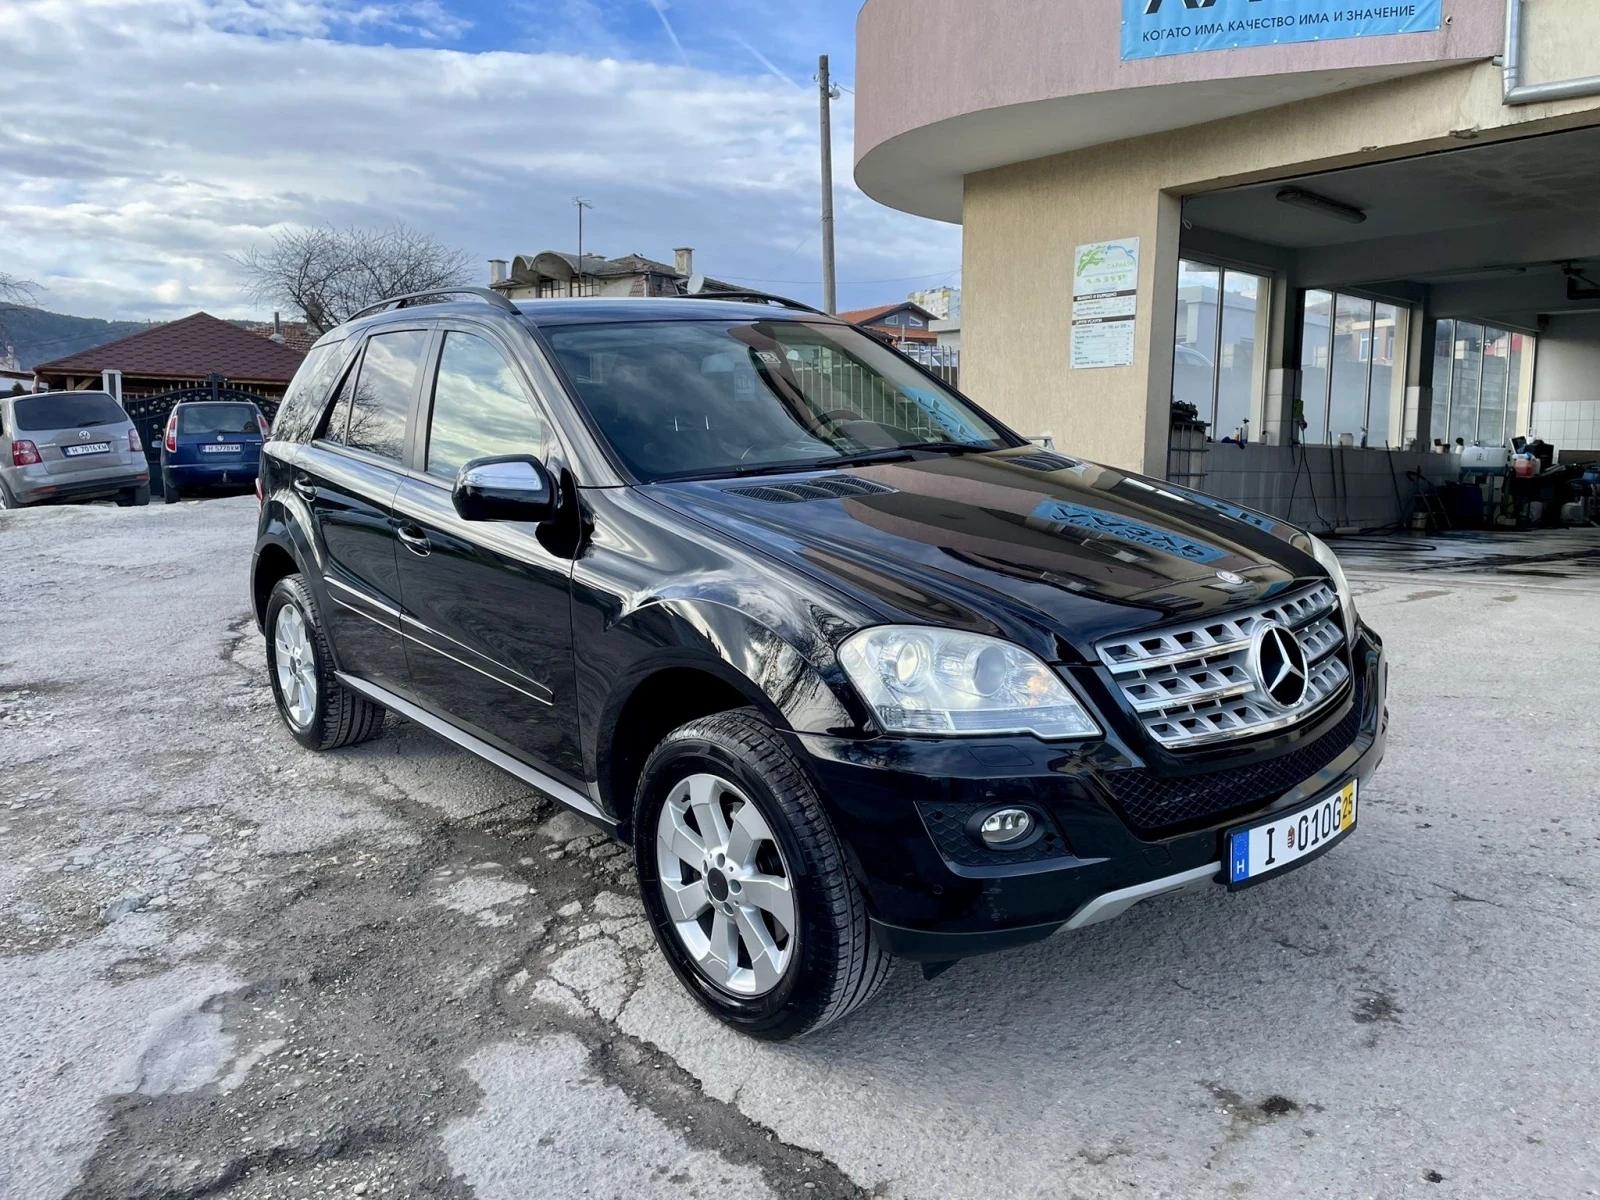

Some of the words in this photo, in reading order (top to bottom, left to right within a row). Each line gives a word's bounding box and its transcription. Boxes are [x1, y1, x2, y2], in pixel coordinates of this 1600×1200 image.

[1142, 26, 1191, 42] КОГАТО
[1195, 23, 1224, 35] ИМА
[1228, 16, 1295, 32] КАЧЕСТВО
[1299, 13, 1330, 25] ИМА
[1334, 11, 1343, 22] И
[1346, 5, 1415, 21] ЗНАЧЕНИЕ
[1342, 792, 1353, 820] 25
[1236, 859, 1245, 875] H
